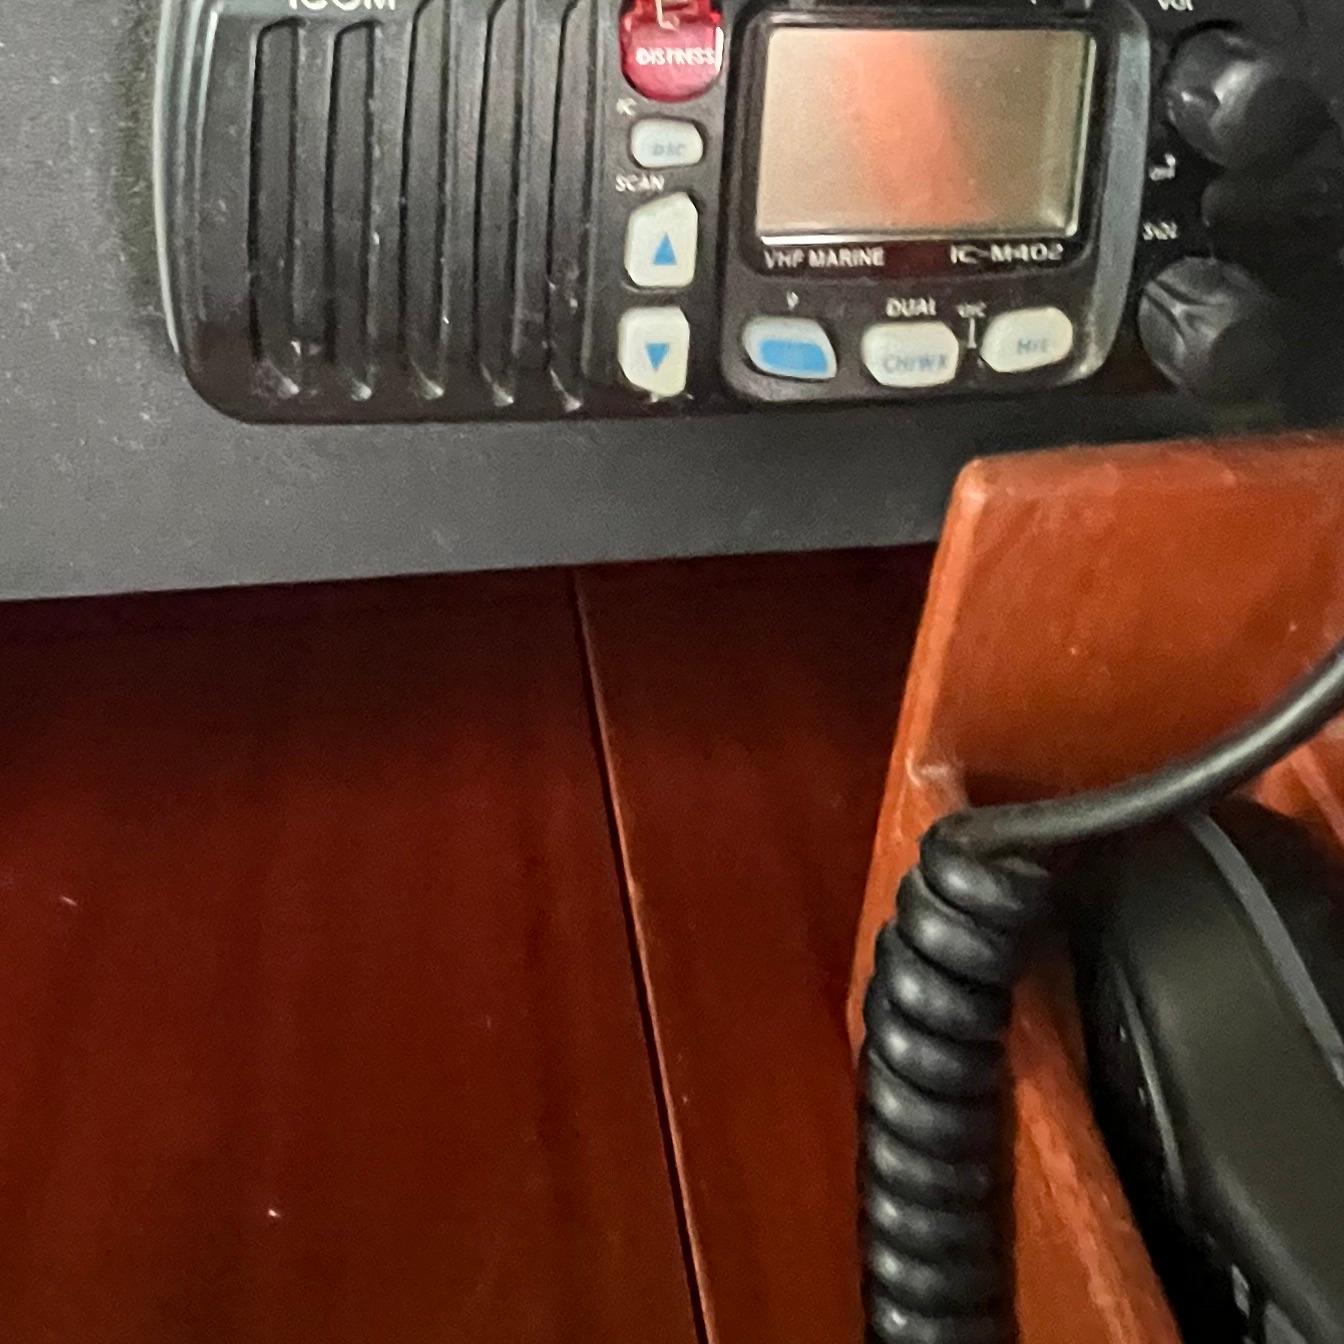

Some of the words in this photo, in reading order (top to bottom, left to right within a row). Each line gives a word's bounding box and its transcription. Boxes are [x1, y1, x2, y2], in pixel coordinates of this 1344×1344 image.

[635, 46, 716, 67] DISTRESS
[614, 173, 666, 193] SCAN
[763, 246, 806, 270] VHF
[808, 244, 886, 269] MARINE
[885, 296, 937, 317] DUAL
